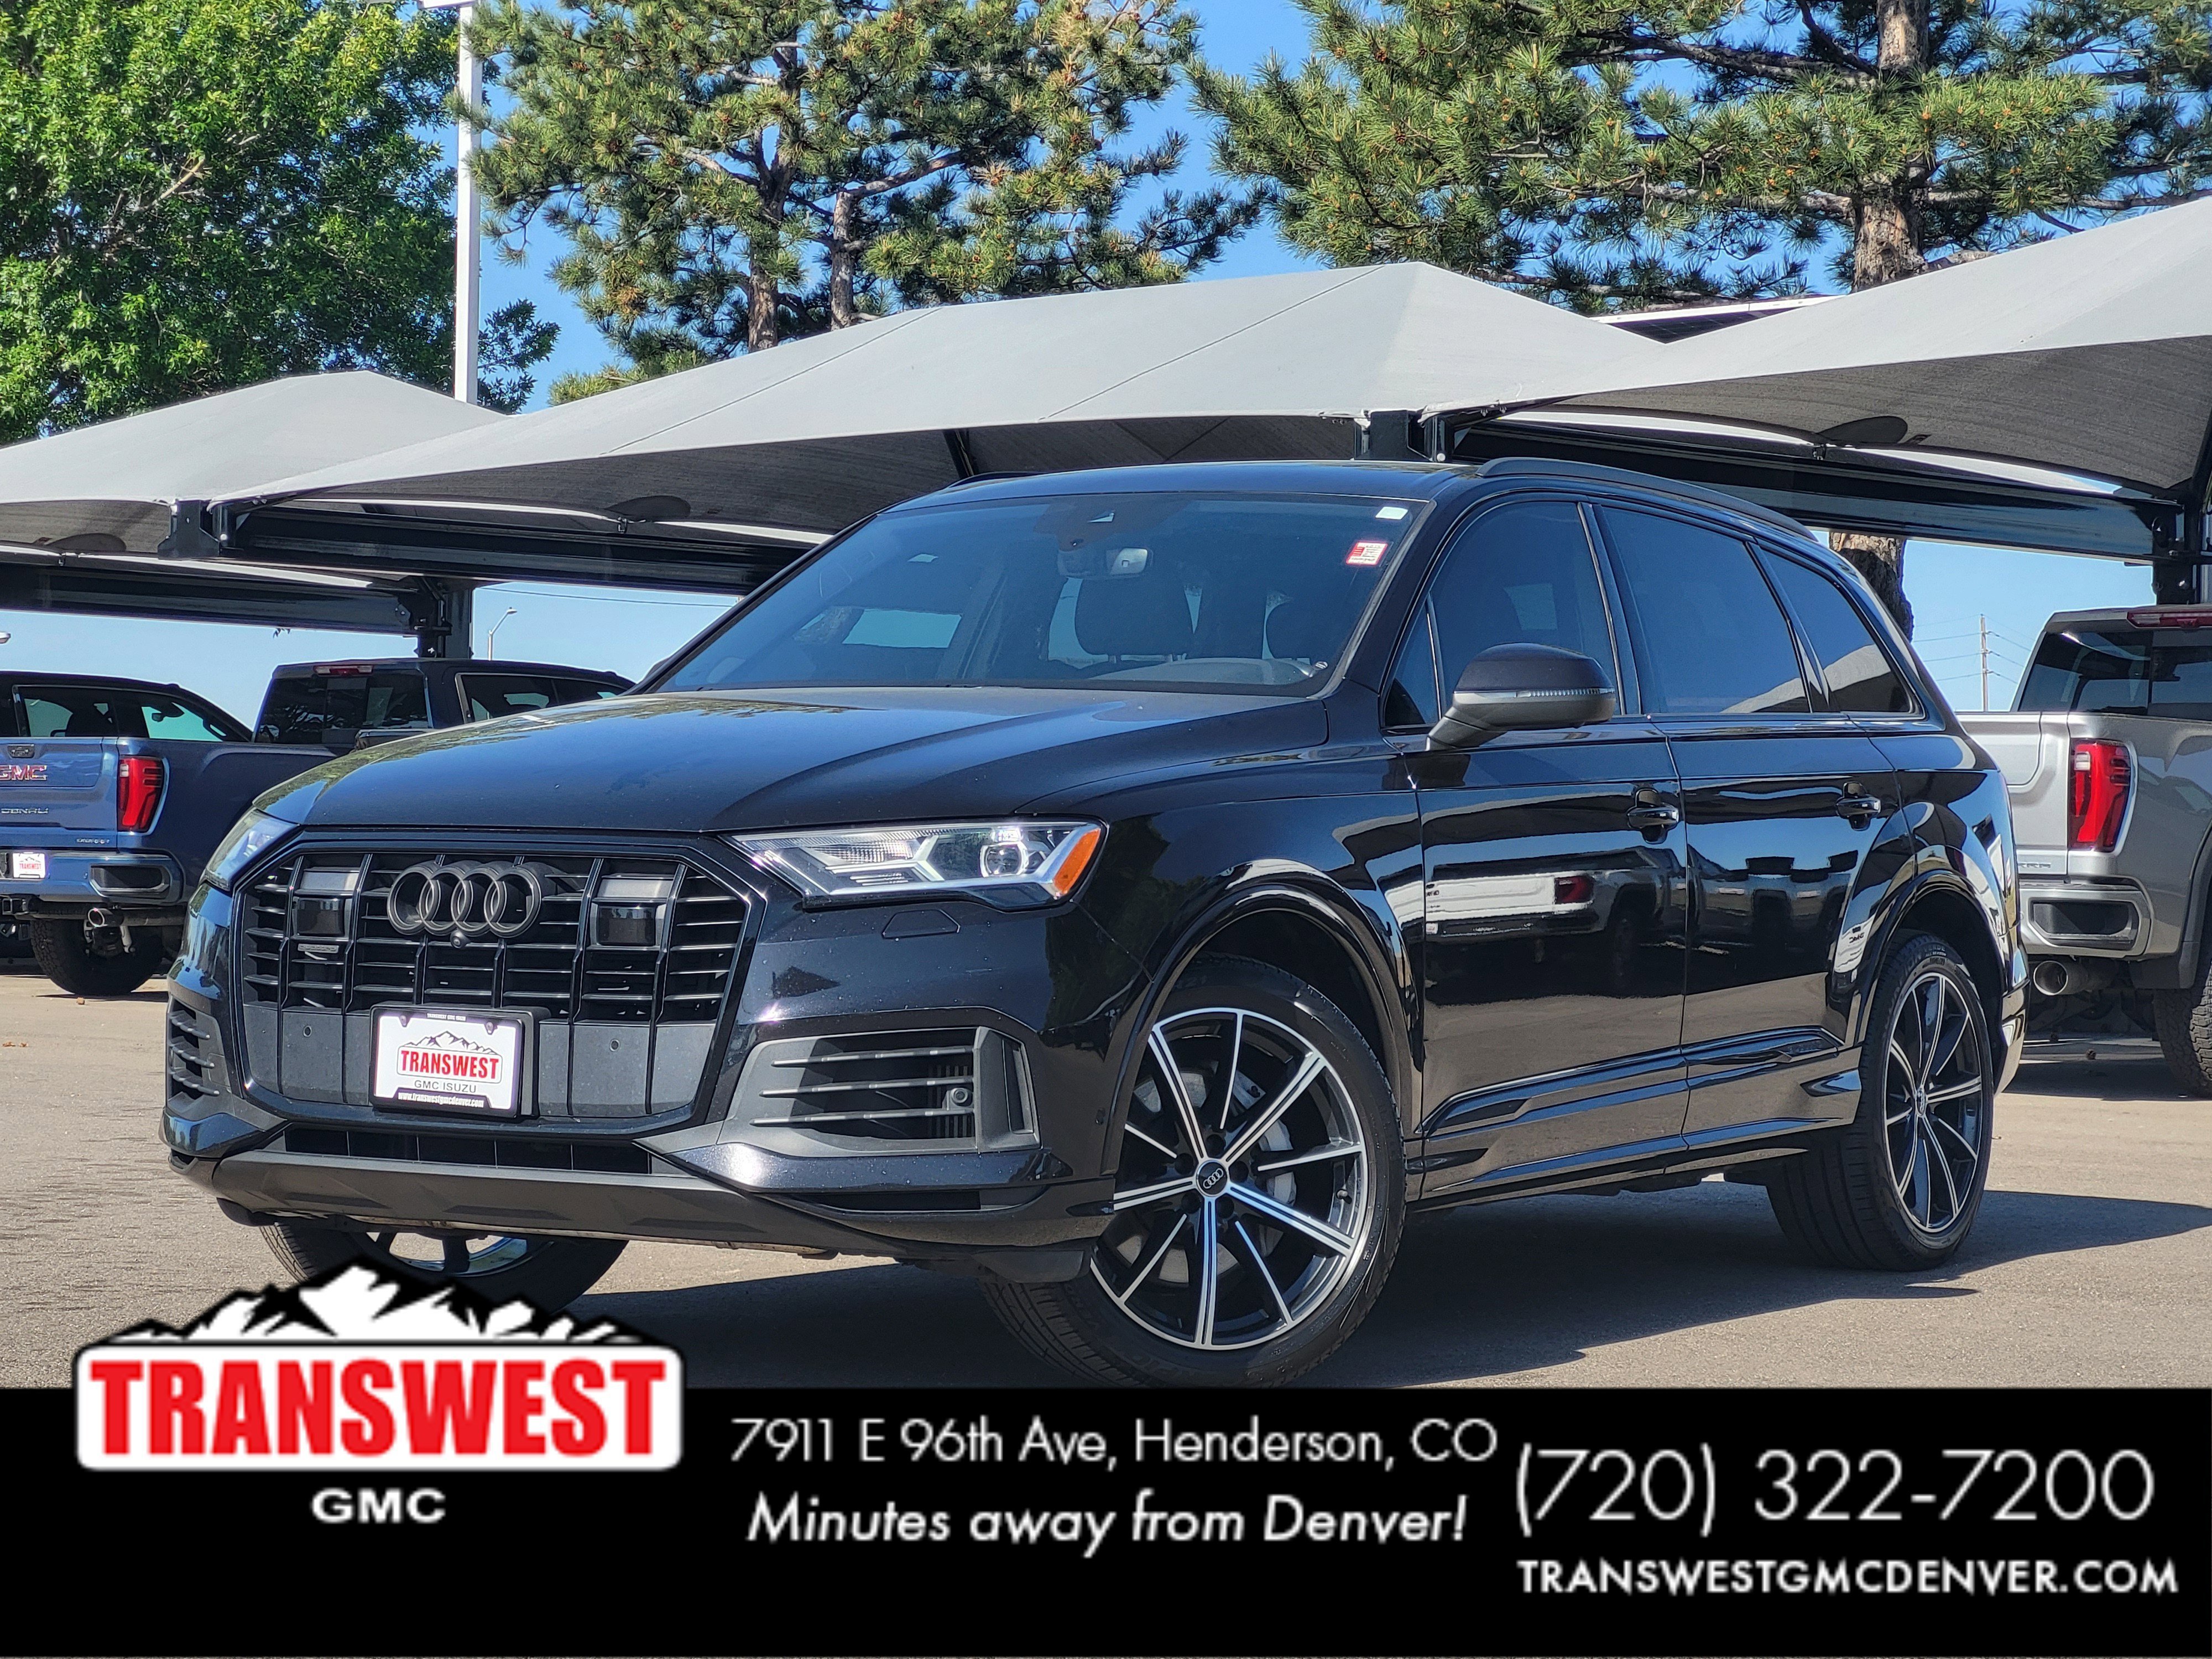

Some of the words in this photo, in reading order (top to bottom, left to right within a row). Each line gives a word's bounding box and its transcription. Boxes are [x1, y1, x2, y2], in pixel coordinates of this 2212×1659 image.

[0, 765, 48, 781] GMC
[401, 1050, 499, 1079] TRANSWEST
[414, 1079, 439, 1090] GMC
[443, 1082, 477, 1093] ISUZU
